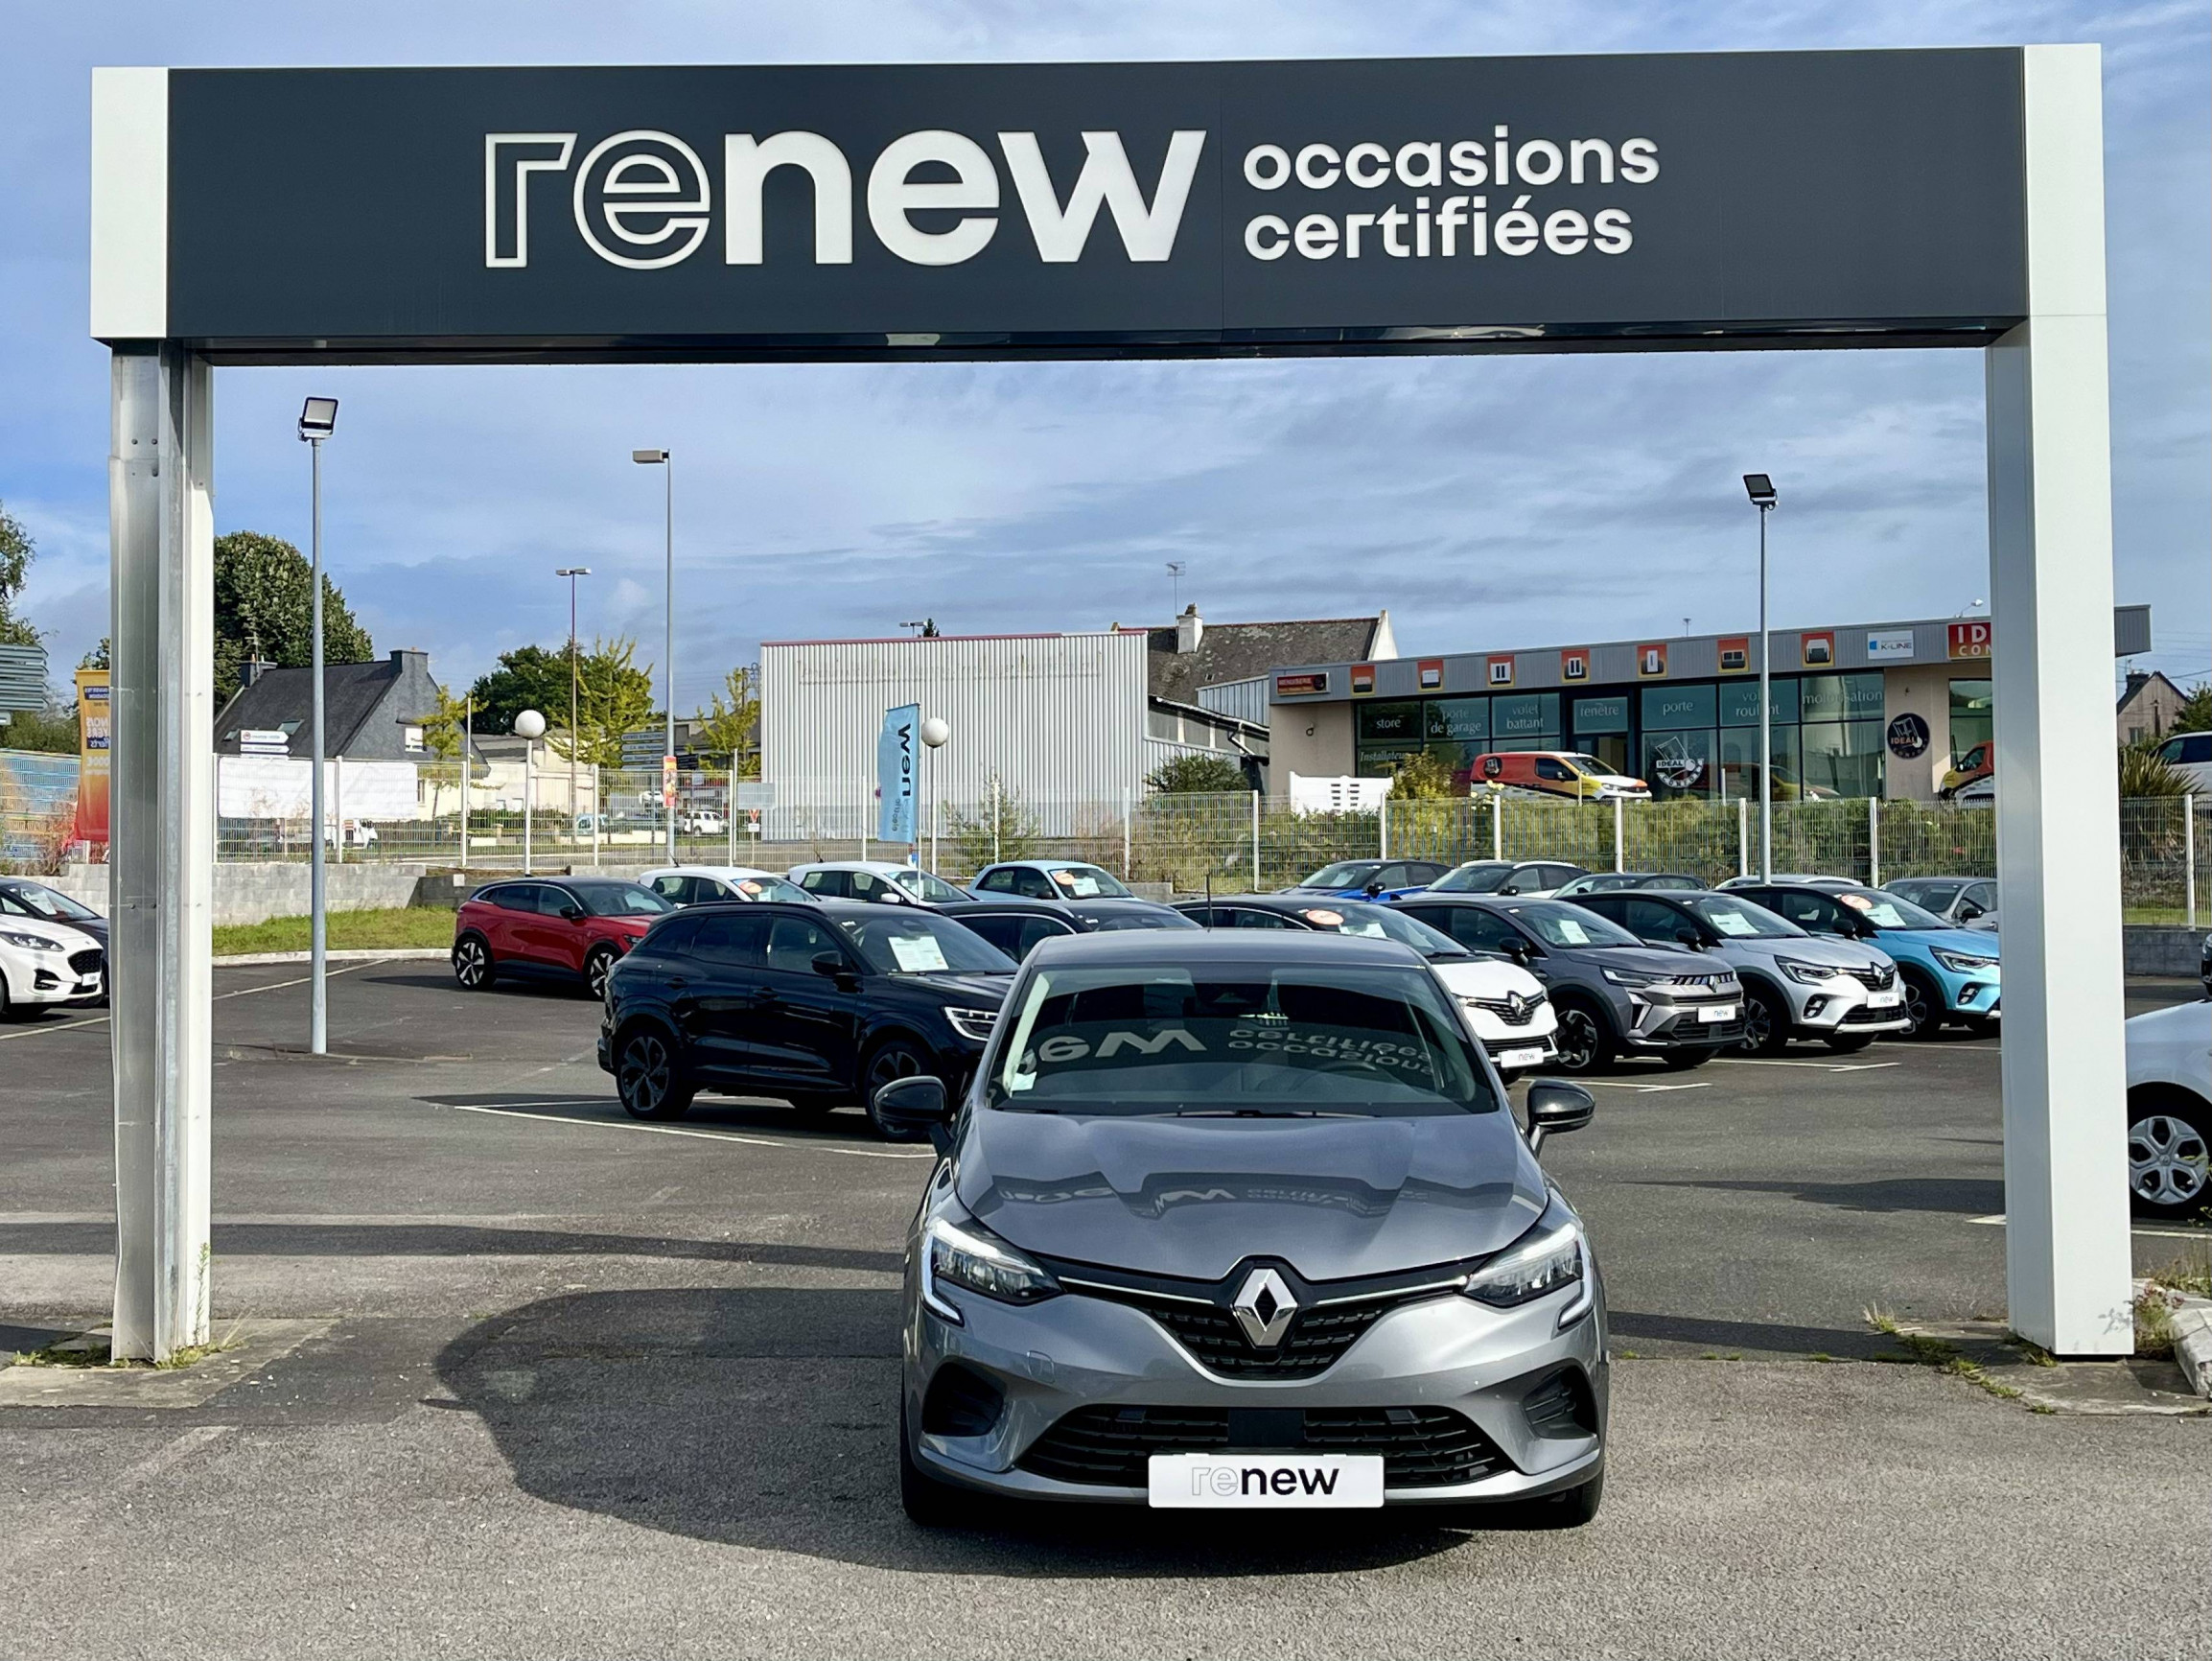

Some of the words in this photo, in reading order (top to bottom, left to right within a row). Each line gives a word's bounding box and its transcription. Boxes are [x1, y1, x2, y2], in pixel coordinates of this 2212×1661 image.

[1244, 124, 1660, 190] occasions
[485, 129, 1207, 269] renew
[1245, 195, 1634, 260] certifiées
[1881, 642, 1912, 650] K-LINE
[1512, 703, 1539, 715] volet
[1663, 700, 1693, 716] porte
[1736, 703, 1781, 716] roulnt
[1442, 709, 1470, 722] porte
[1376, 718, 1401, 729] store
[1431, 721, 1444, 734] de
[1446, 722, 1481, 736] garage
[1506, 717, 1544, 730] battant
[1890, 737, 1916, 745] IDEAL
[1192, 1467, 1339, 1496] renew
